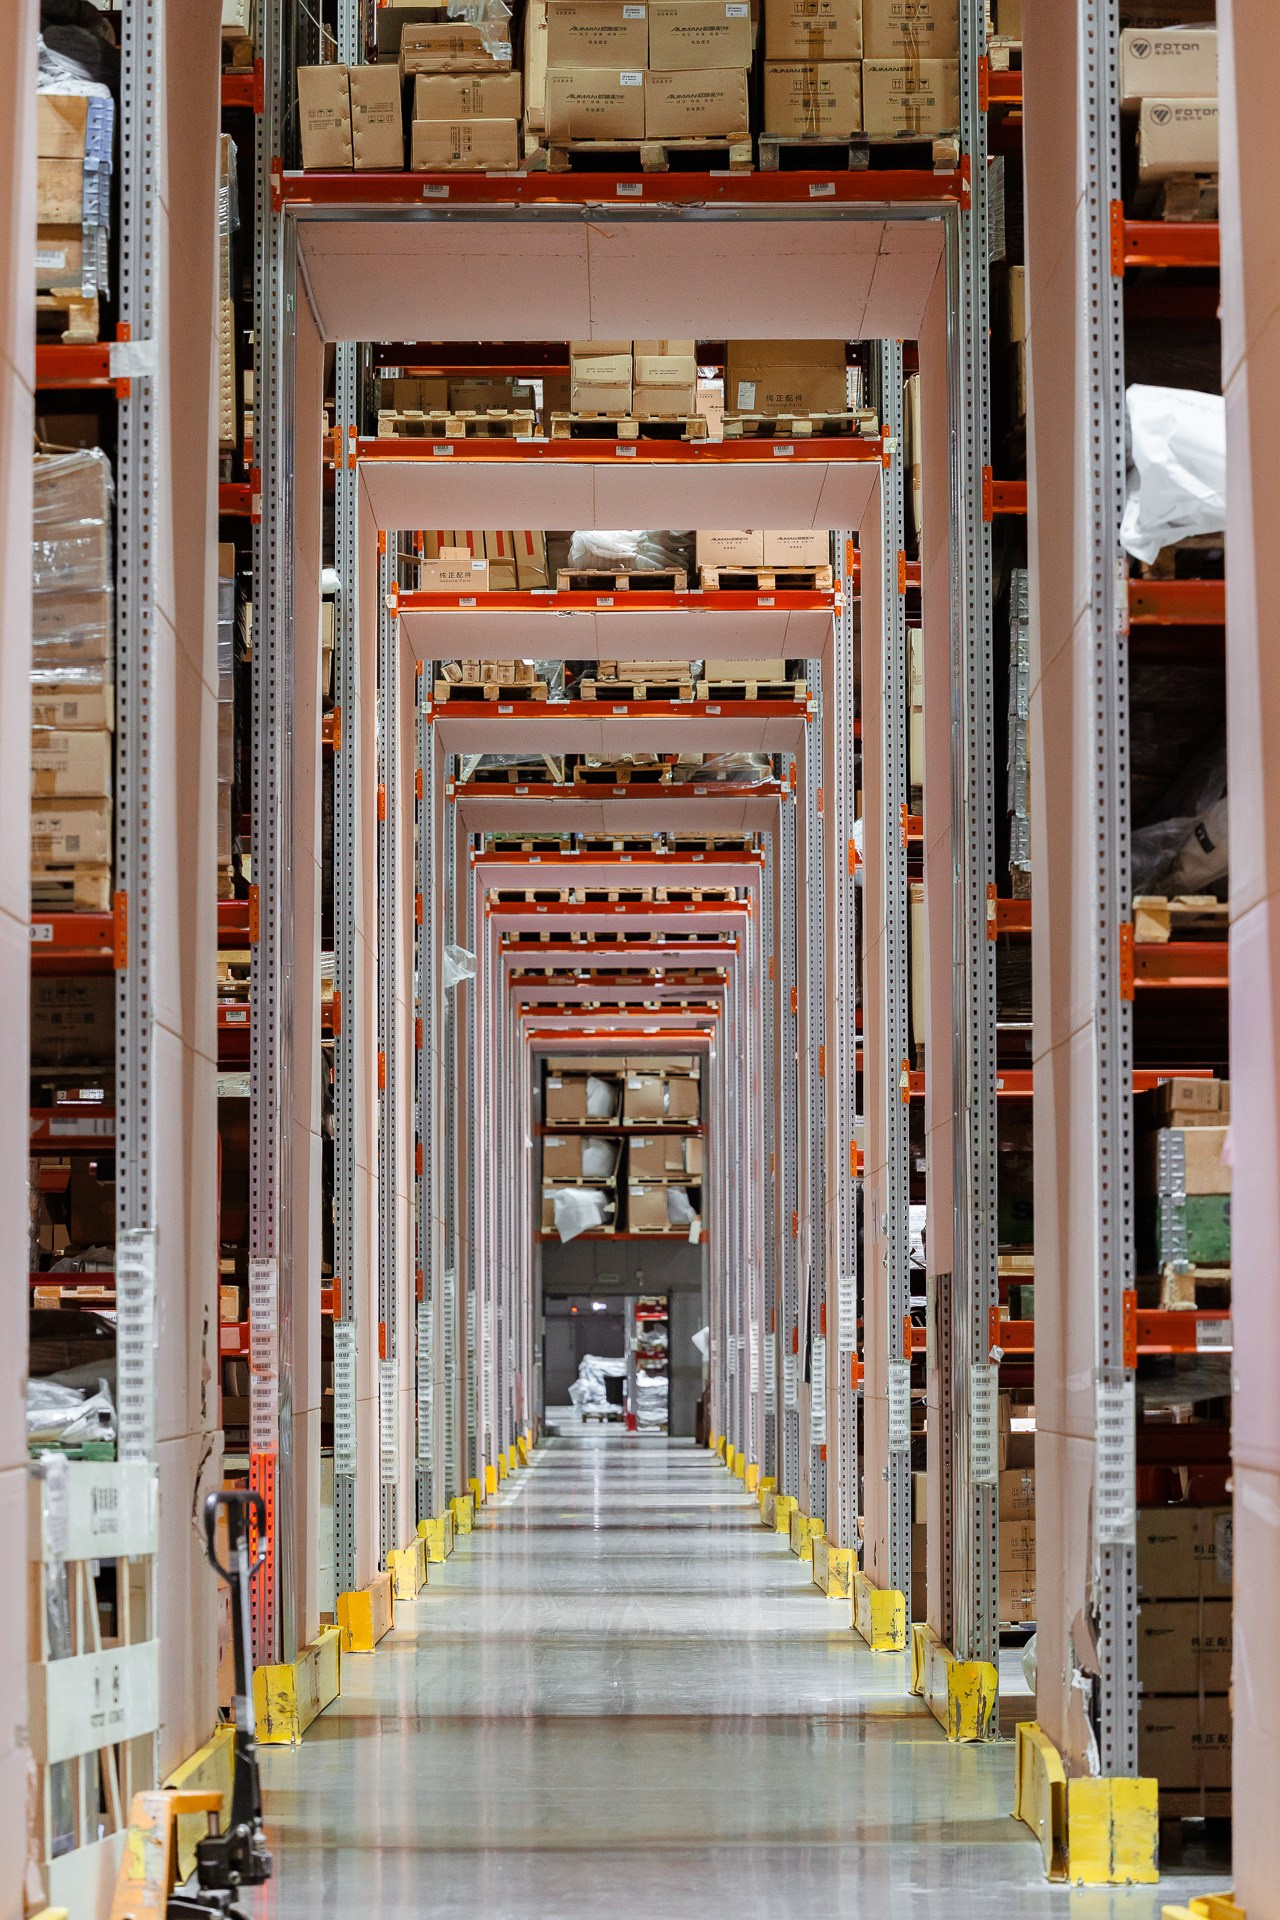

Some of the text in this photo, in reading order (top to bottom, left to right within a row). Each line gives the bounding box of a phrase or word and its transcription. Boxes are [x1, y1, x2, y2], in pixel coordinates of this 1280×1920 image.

[1154, 43, 1200, 51] FOTON
[765, 394, 803, 402] 纯正配件
[439, 571, 472, 579] 纯正配件
